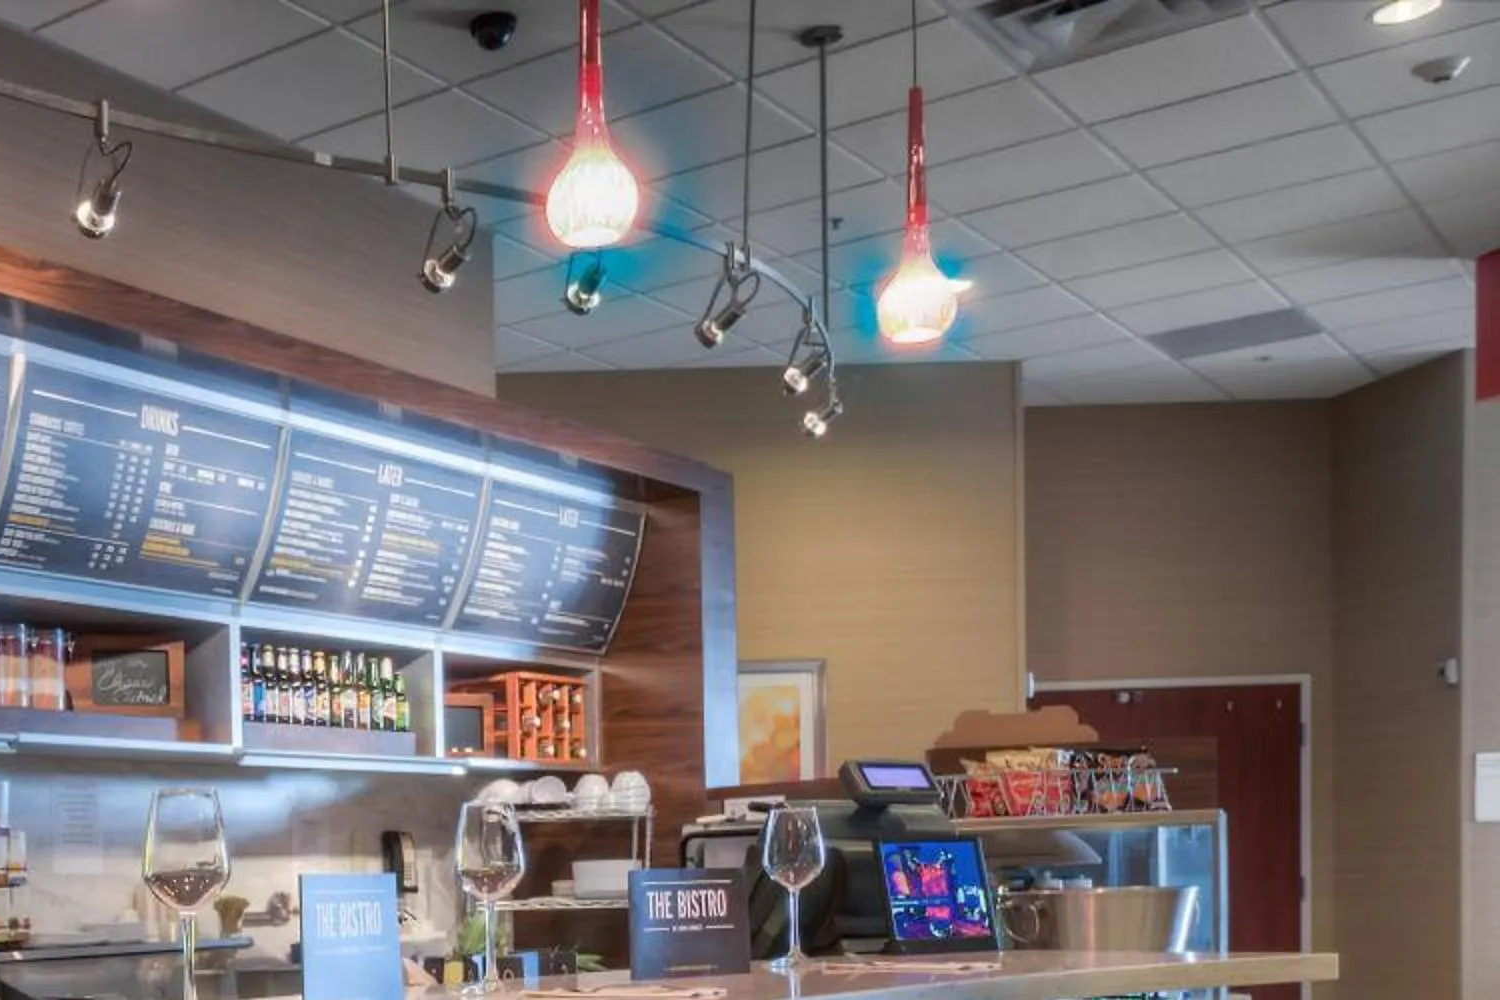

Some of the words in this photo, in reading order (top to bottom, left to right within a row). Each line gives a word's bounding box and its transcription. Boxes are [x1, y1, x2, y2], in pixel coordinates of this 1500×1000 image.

[141, 404, 180, 437] DRINKS
[315, 902, 337, 938] THE
[338, 900, 382, 938] BISTRO
[646, 891, 673, 920] THE
[677, 889, 727, 919] BISTRO
